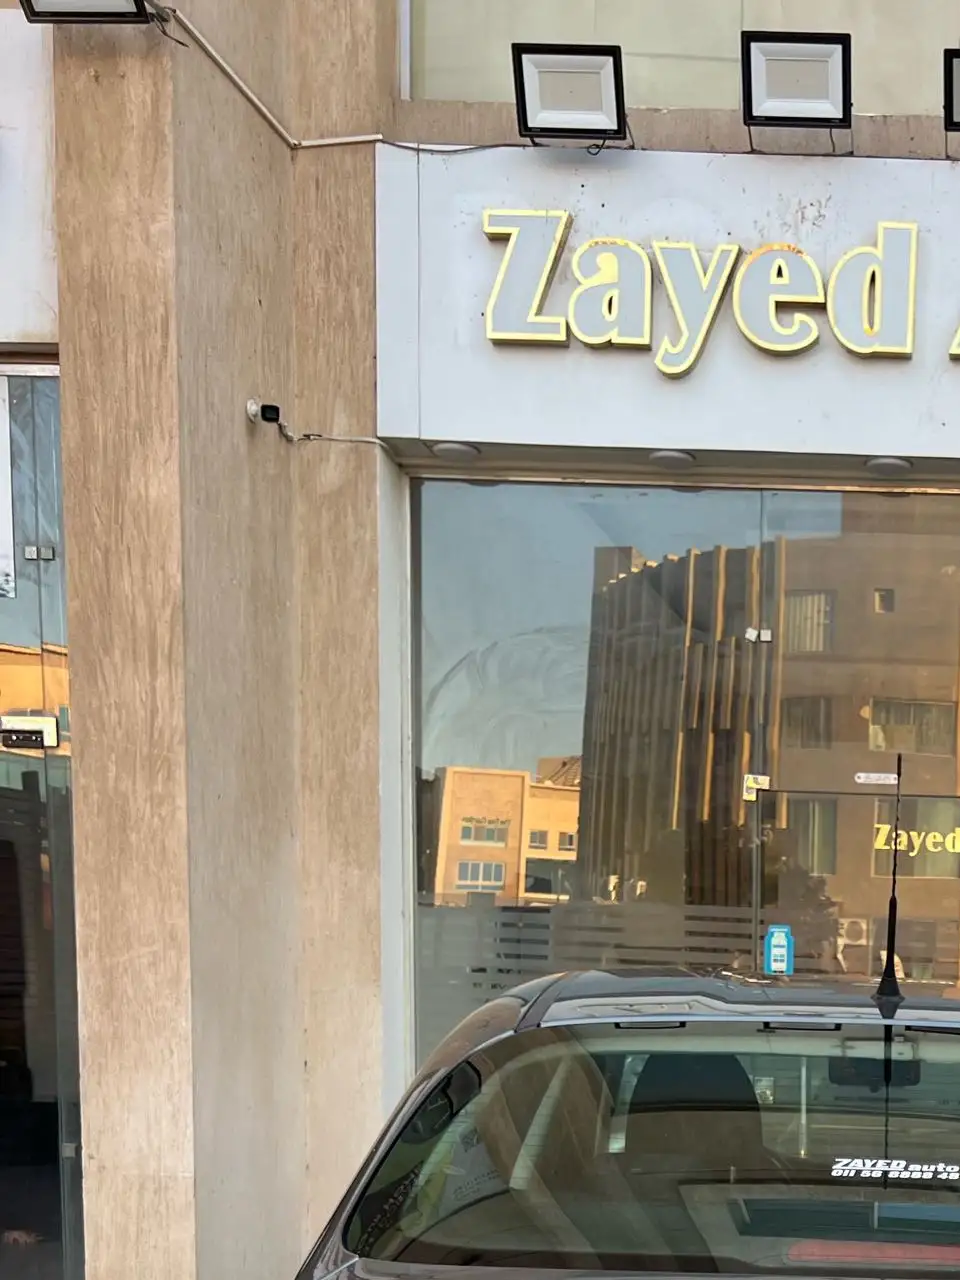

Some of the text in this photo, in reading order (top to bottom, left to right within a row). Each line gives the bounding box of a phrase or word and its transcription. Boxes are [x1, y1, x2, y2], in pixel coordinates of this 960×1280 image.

[482, 208, 918, 378] Zayed
[831, 1158, 960, 1173] ZAYED auto
